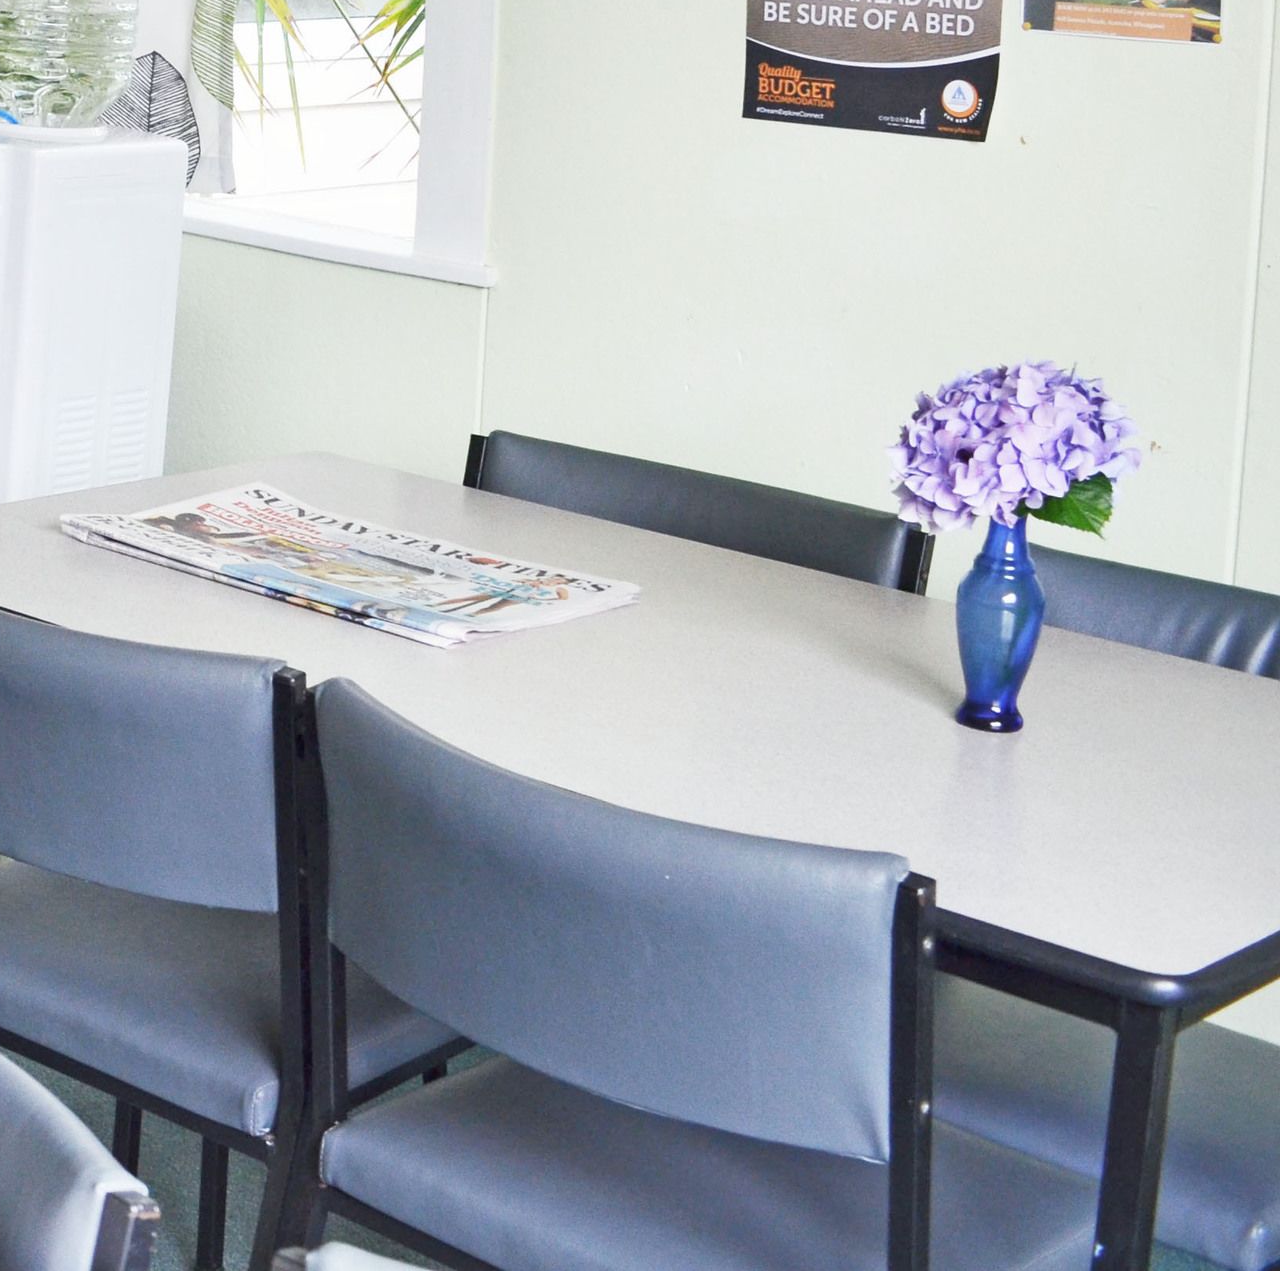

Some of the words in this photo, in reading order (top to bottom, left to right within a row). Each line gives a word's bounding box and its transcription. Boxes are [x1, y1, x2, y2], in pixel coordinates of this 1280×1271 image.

[764, 2, 791, 23] BE
[797, 4, 857, 28] SURE
[864, 9, 897, 30] OF
[902, 12, 919, 33] A
[926, 13, 974, 36] BED
[758, 62, 801, 82] Quality
[758, 77, 836, 99] BUDGET
[758, 93, 835, 108] ACCOMMODATION
[243, 487, 378, 535] SUNDAY
[376, 533, 483, 560] STAR
